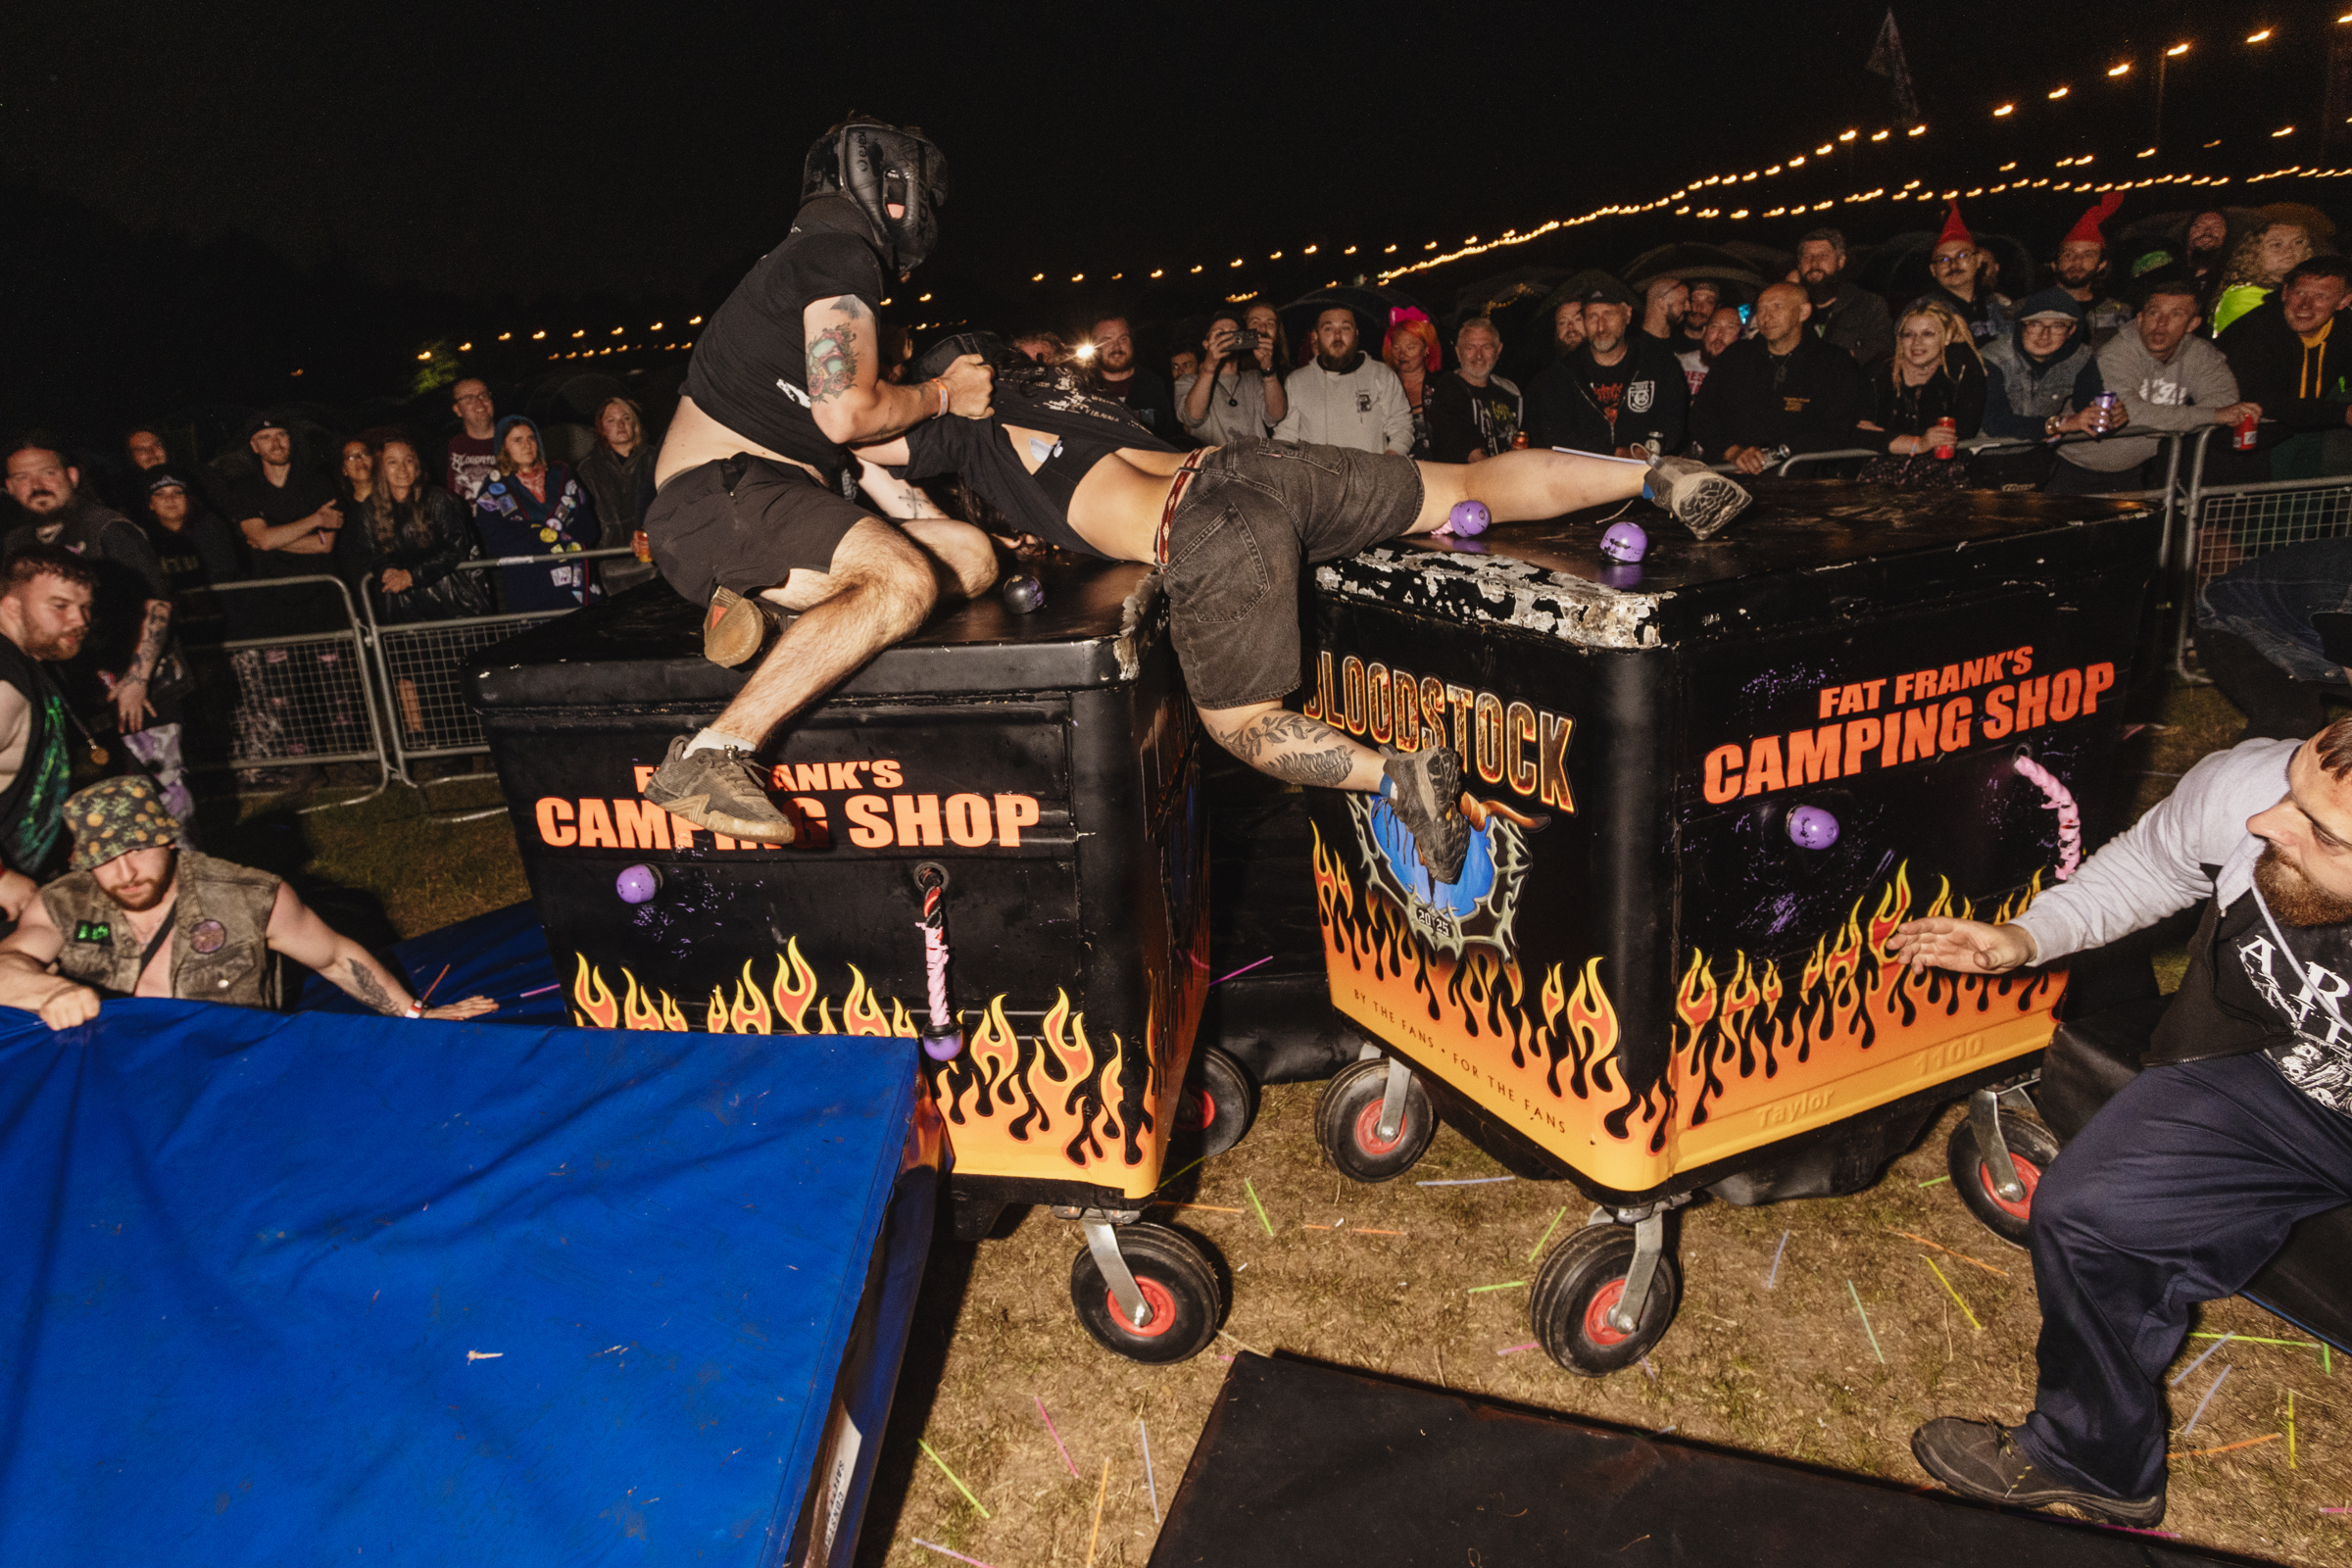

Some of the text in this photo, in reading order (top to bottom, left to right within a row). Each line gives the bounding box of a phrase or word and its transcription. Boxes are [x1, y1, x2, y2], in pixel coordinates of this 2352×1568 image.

[1819, 645, 2034, 719] FAT FRANK'S
[1703, 662, 2115, 806] CAMPING SHOP
[845, 793, 1041, 849] SHOP
[1353, 988, 1566, 1134] BY THE FANS FOR THE FANS
[1914, 1034, 1984, 1074] 1100
[1756, 1088, 1835, 1129] Taylor
